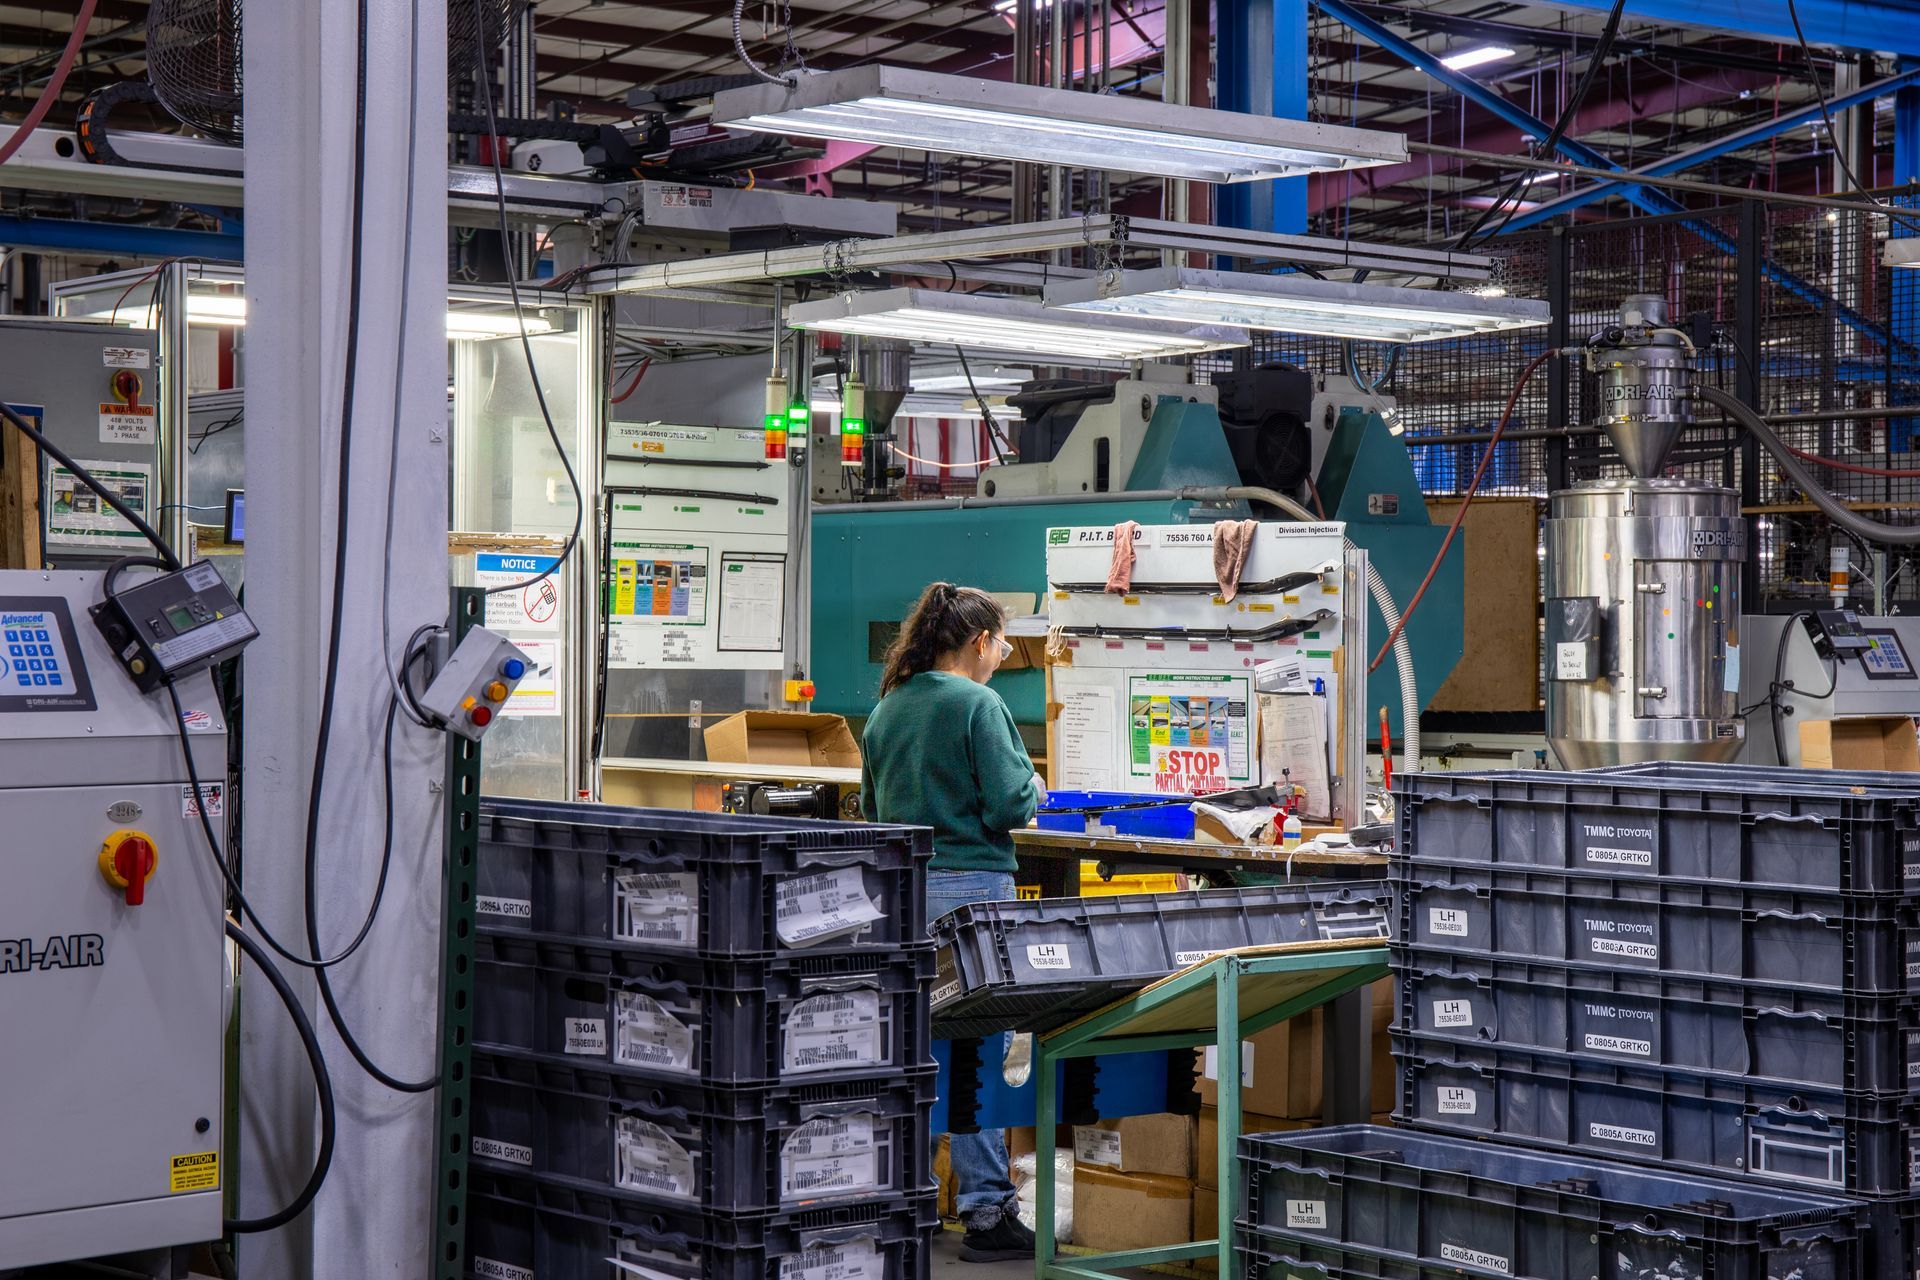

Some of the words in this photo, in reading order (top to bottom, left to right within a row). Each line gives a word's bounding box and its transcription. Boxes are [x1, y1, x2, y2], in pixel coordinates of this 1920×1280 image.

[1613, 384, 1675, 400] DRI-AIR
[1080, 532, 1104, 541] P.I.T.
[1308, 526, 1338, 535] Injection
[1166, 534, 1189, 542] 75536
[1191, 534, 1205, 542] 760
[1705, 530, 1744, 546] DRI-AIR
[502, 559, 536, 570] NOTICE
[1, 613, 43, 625] Advanced
[37, 676, 43, 684] 0
[1168, 750, 1220, 775] STOP
[1155, 773, 1185, 793] PARTIAL
[1186, 774, 1226, 792] CONTAINER
[1584, 825, 1614, 837] TMMC
[1617, 828, 1652, 840] [TOYOTA]
[1587, 850, 1593, 858] C
[1595, 851, 1618, 860] 0805A
[1620, 853, 1650, 863] GRTKO
[503, 903, 530, 916] GRTKO
[1440, 910, 1455, 921] LH
[1584, 919, 1615, 932] TMMC
[1617, 923, 1653, 935] [TOYOTA]
[0, 934, 104, 974] RI-AIR
[1038, 946, 1055, 956] LH
[1592, 941, 1598, 949] C
[1600, 941, 1624, 953] 0805A
[1626, 945, 1656, 957] GRTKO
[1184, 953, 1205, 962] 0805A
[1444, 1002, 1459, 1013] LH
[1585, 1004, 1616, 1018] TMMC
[1618, 1008, 1654, 1023] [TOYOTA]
[574, 1022, 597, 1034] 760A
[1586, 1036, 1592, 1045] C
[1594, 1037, 1618, 1048] 0805A
[1620, 1041, 1649, 1052] GRTKO
[1448, 1089, 1464, 1100] LH
[1591, 1127, 1597, 1135] C
[1599, 1128, 1622, 1139] 0805A
[1625, 1132, 1655, 1143] GRTKO
[473, 1140, 480, 1152] C
[481, 1142, 502, 1156] 0805A
[504, 1147, 531, 1163] GRTKO
[177, 1155, 213, 1167] CAUTION
[1297, 1202, 1313, 1214] LH
[1442, 1247, 1448, 1256] C
[1451, 1249, 1474, 1263] 0805A
[1476, 1256, 1507, 1270] GRTKO
[475, 1260, 482, 1272] C
[483, 1261, 503, 1276] 0805A
